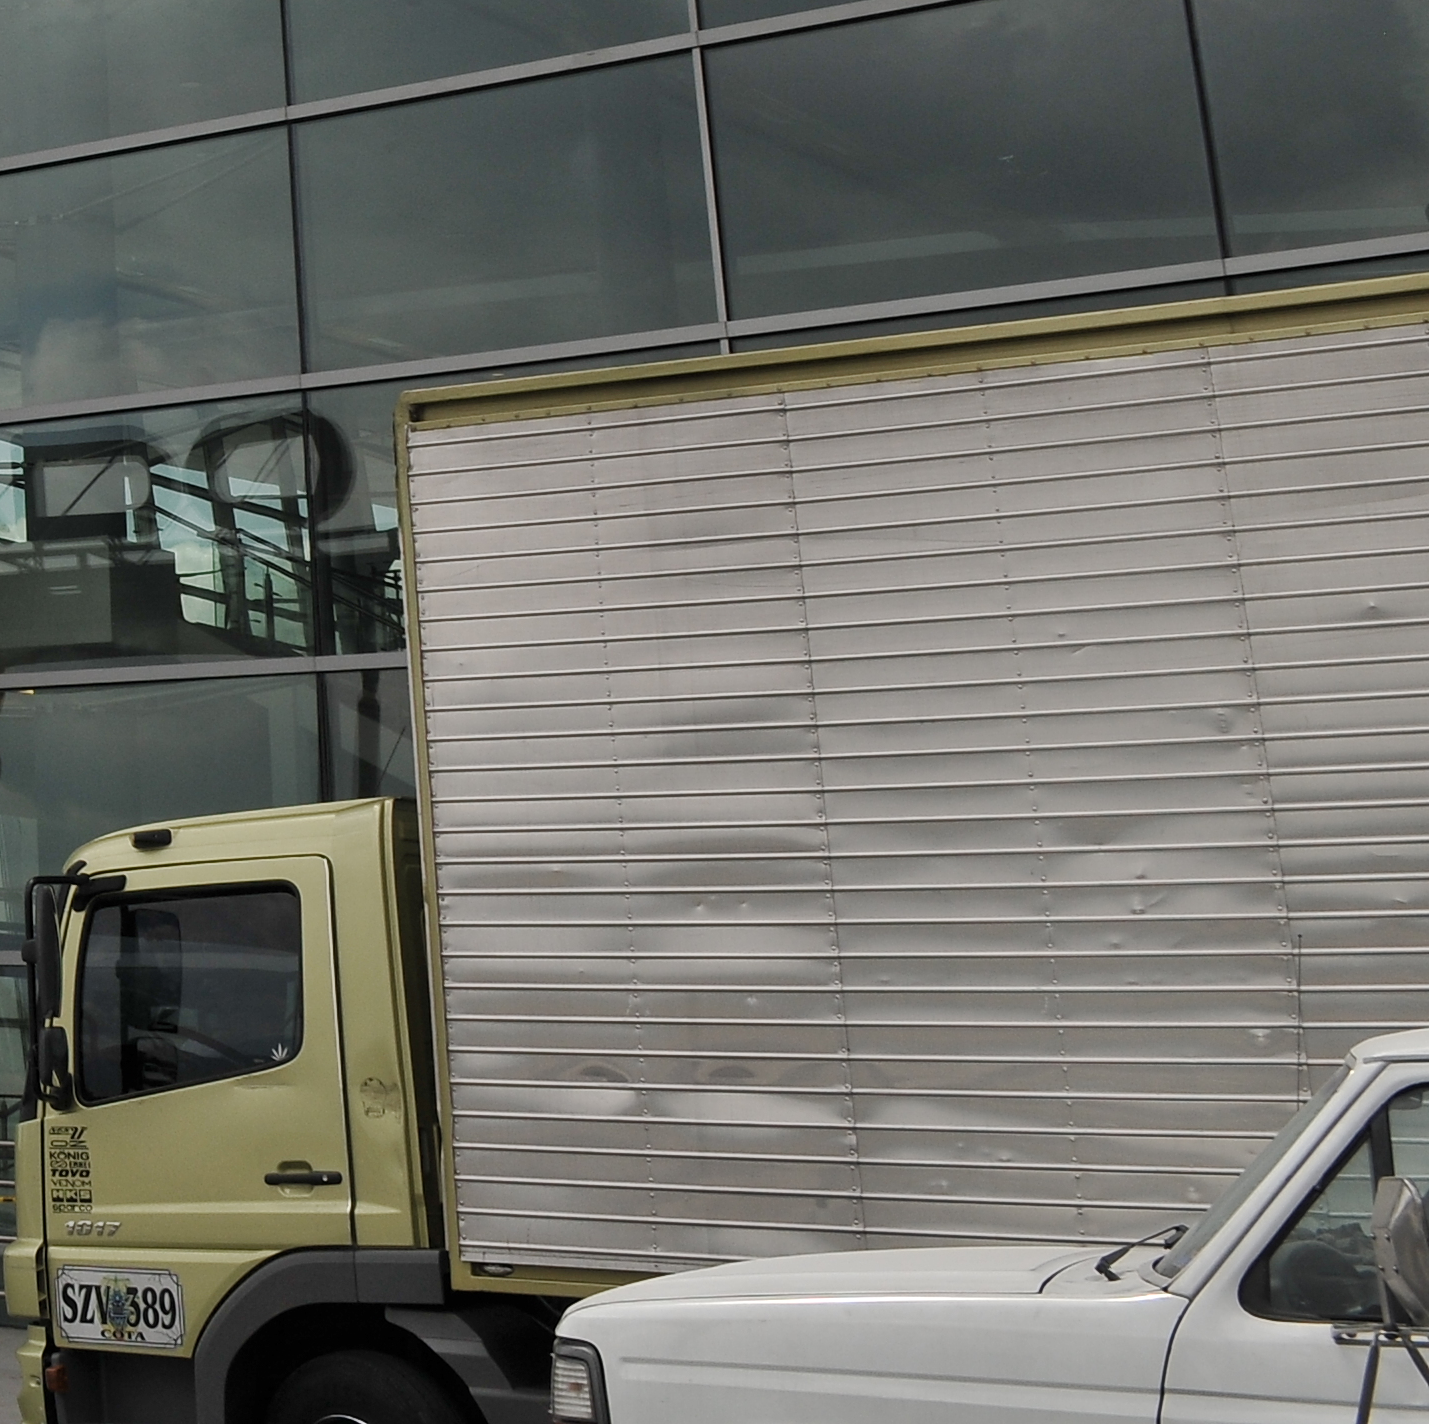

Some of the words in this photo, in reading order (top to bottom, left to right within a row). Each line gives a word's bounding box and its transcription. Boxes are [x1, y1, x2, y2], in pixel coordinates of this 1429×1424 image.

[51, 1188, 92, 1203] HKS
[64, 1220, 122, 1237] 1017
[62, 1282, 111, 1324] SZV
[126, 1286, 177, 1330] 389
